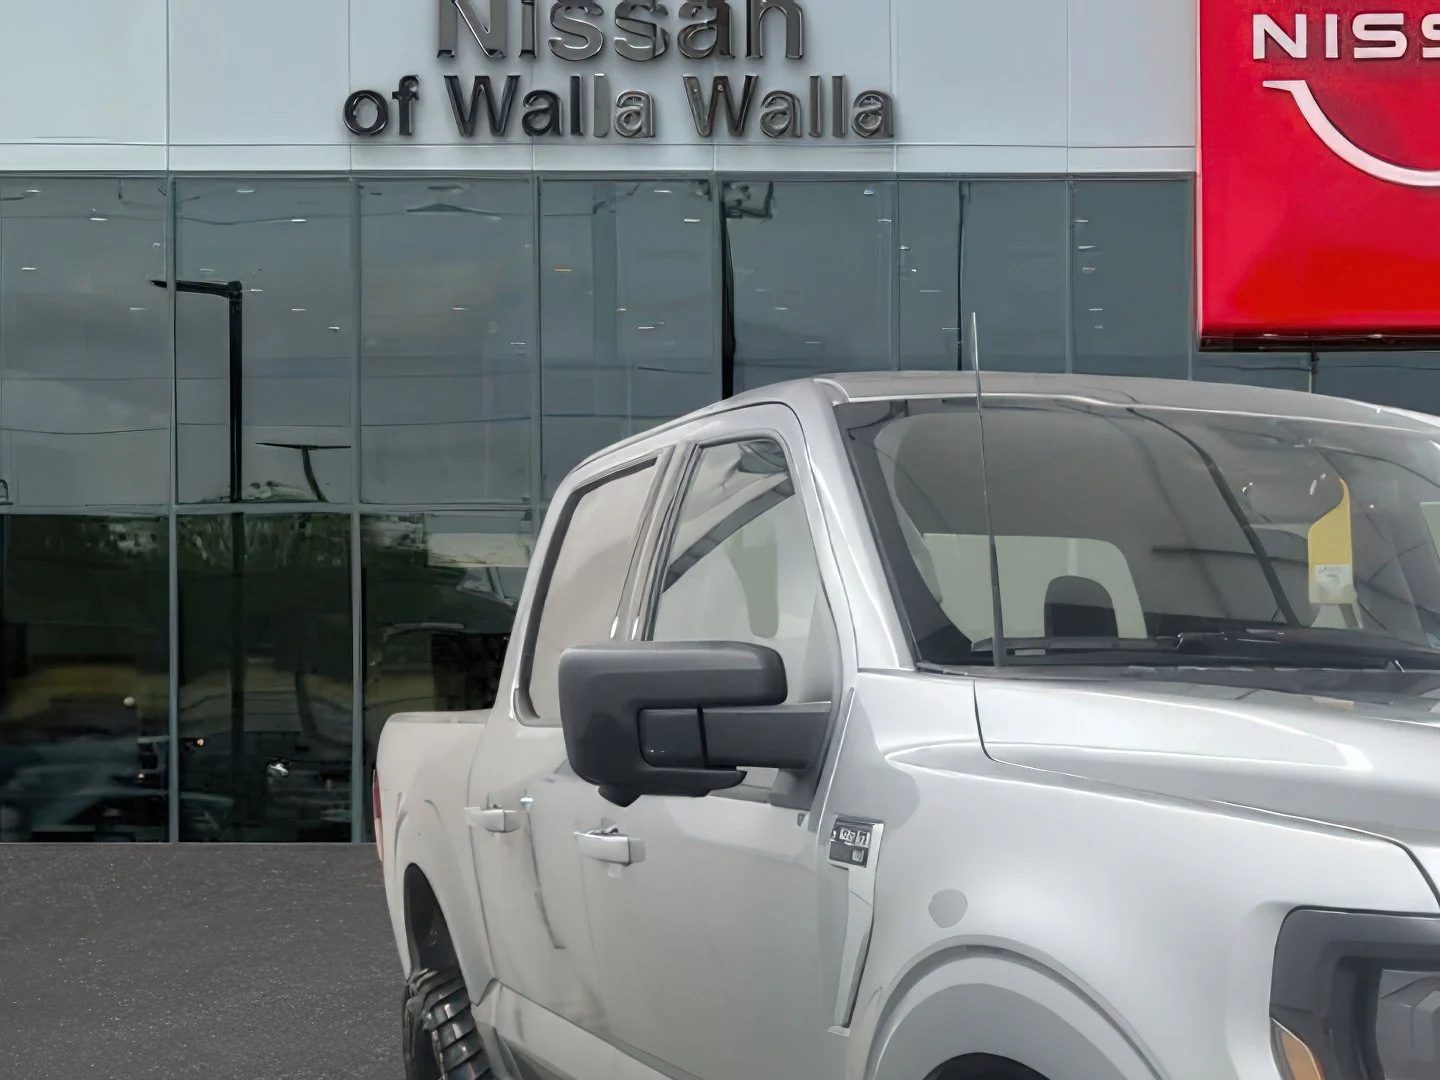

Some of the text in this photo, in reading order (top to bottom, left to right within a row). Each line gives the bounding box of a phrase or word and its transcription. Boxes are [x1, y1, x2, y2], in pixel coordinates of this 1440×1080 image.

[436, 0, 806, 60] Nissan
[343, 73, 894, 138] of Walla Walla
